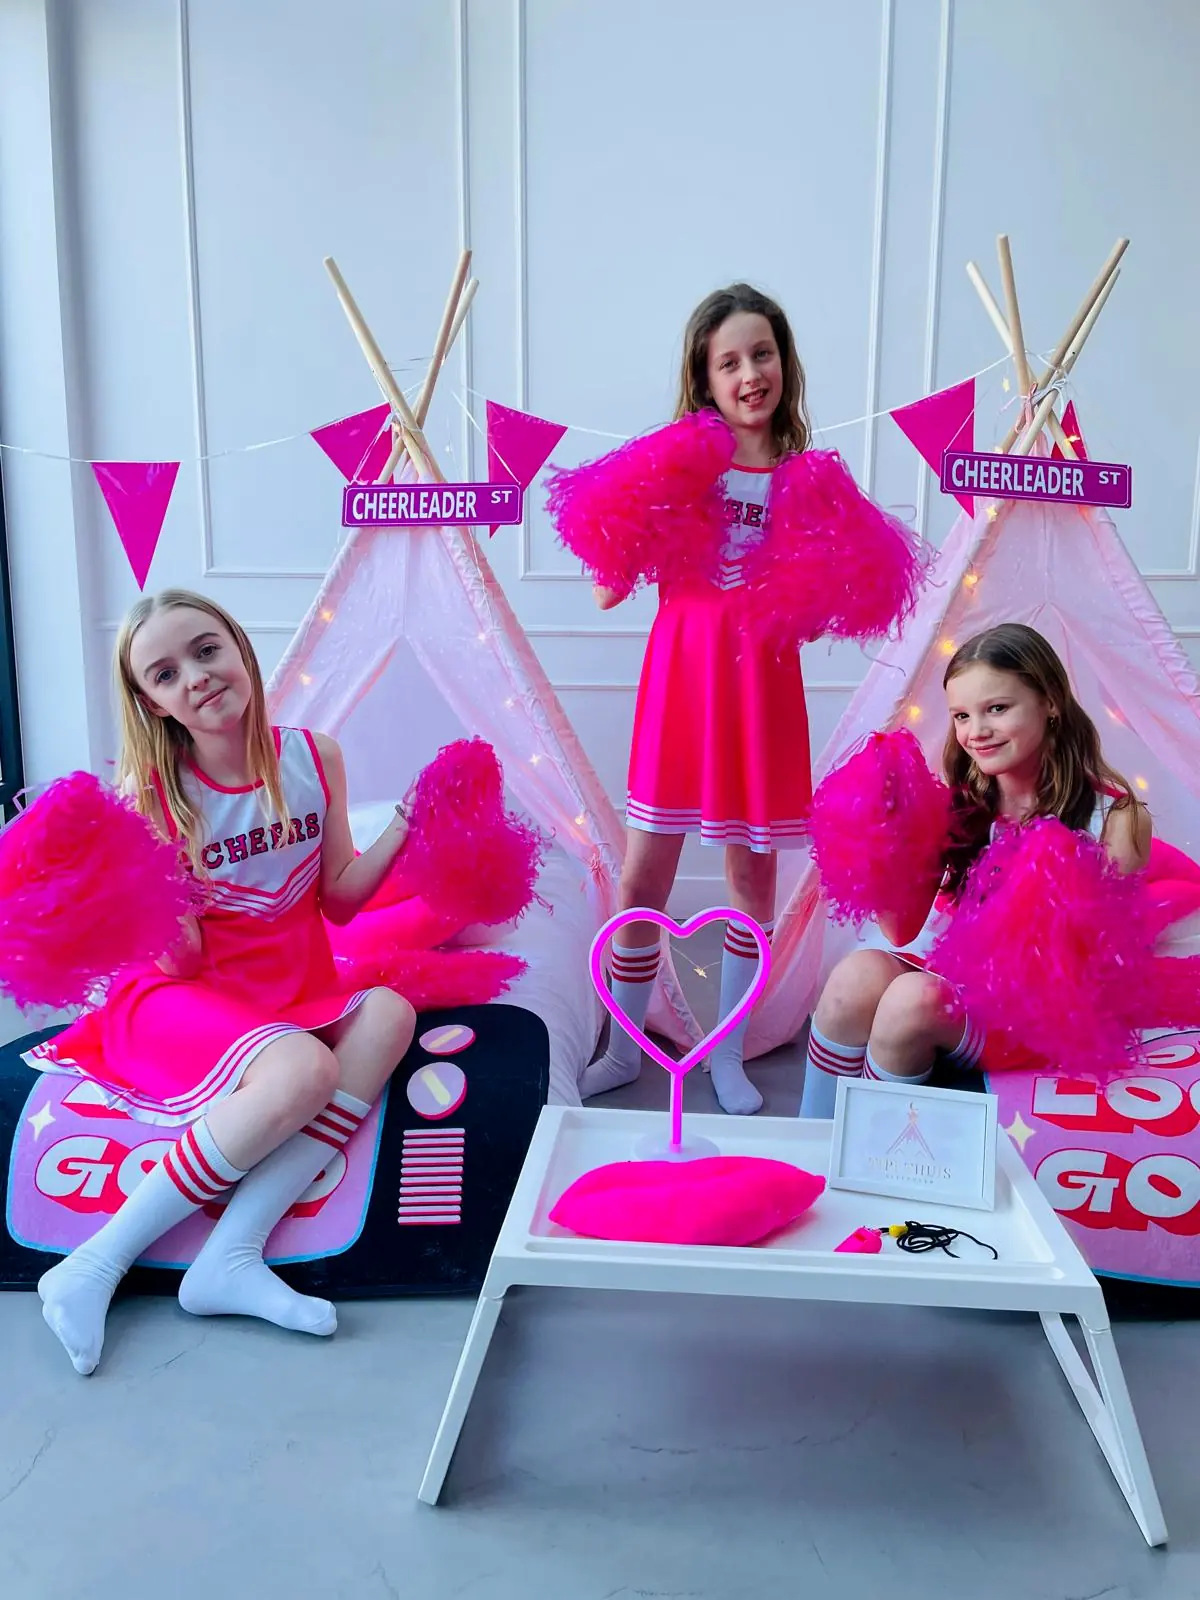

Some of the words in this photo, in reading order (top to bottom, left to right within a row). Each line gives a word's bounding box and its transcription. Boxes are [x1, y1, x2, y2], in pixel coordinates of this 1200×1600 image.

[952, 458, 1084, 497] CHEERLEADER
[1098, 471, 1121, 485] ST
[352, 491, 477, 520] CHEERLEADER
[490, 490, 512, 504] ST
[201, 812, 321, 870] CHEERS
